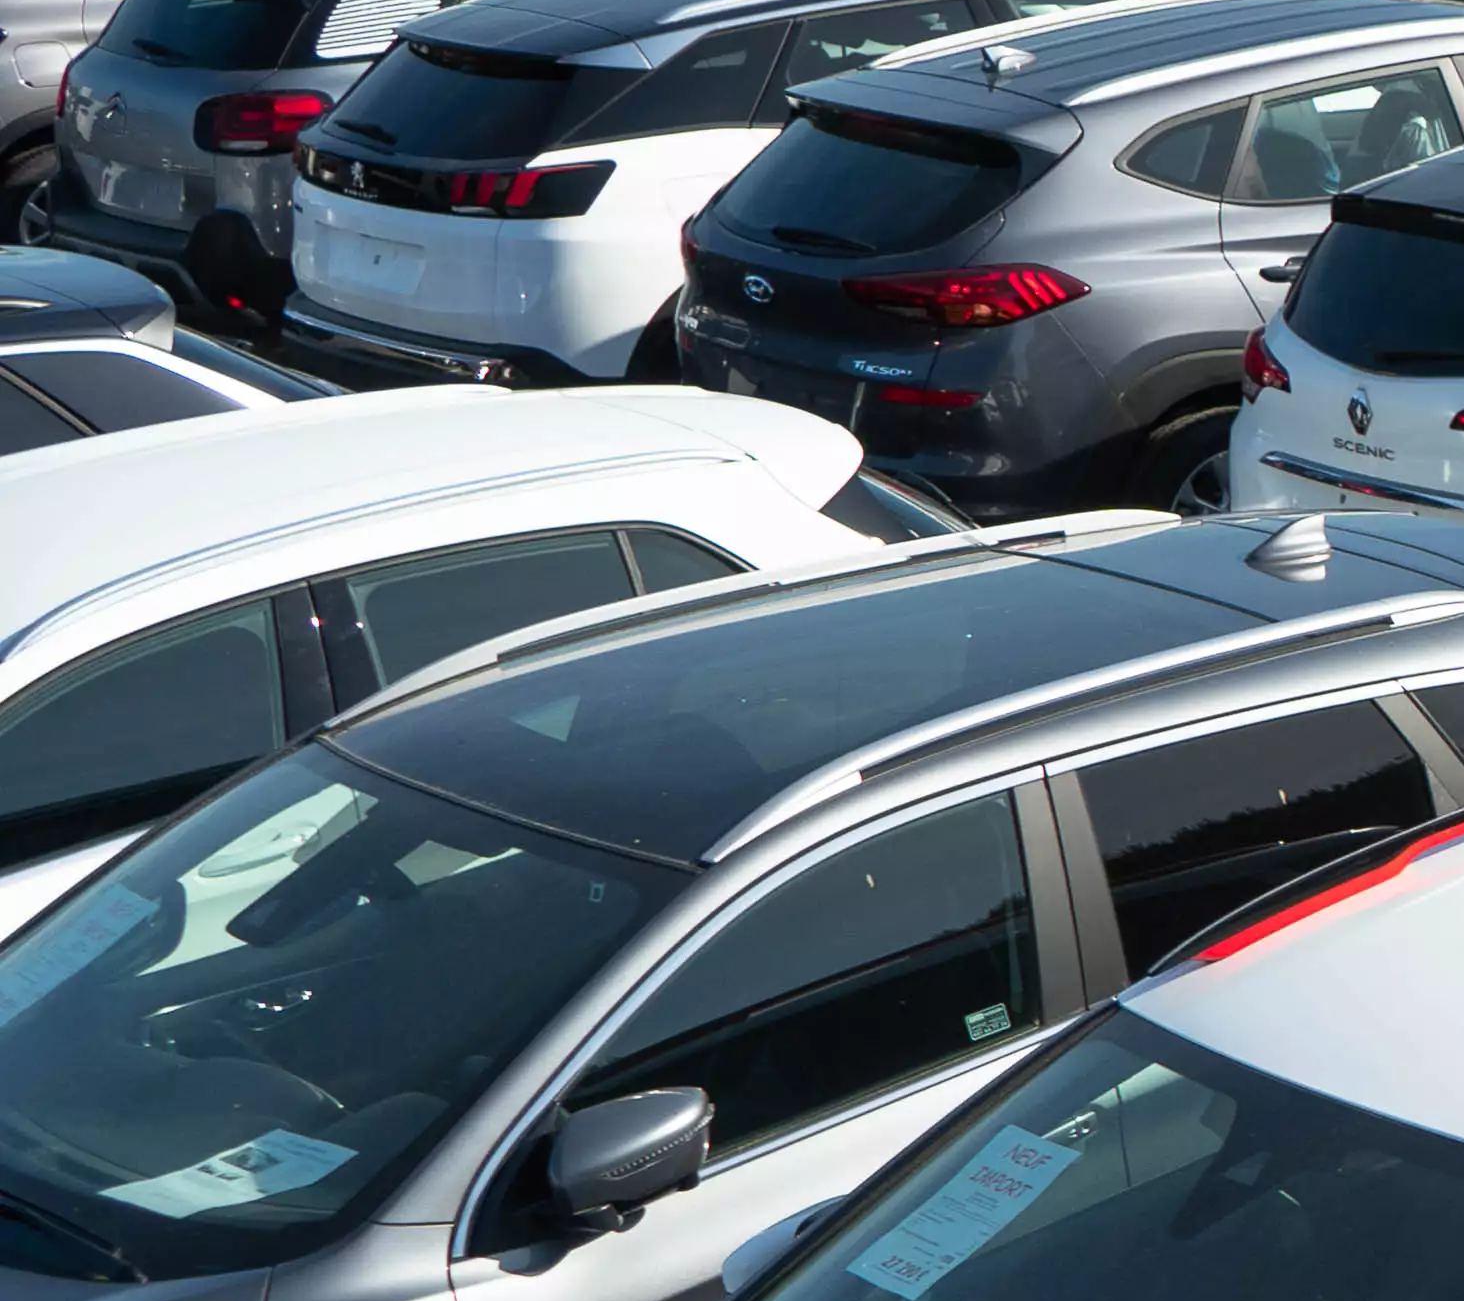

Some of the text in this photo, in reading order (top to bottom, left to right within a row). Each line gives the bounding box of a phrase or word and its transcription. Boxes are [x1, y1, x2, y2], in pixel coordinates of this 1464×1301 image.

[1333, 437, 1395, 461] SCENIC
[1002, 1144, 1052, 1170] NEUF
[969, 1165, 1033, 1198] IMPORT
